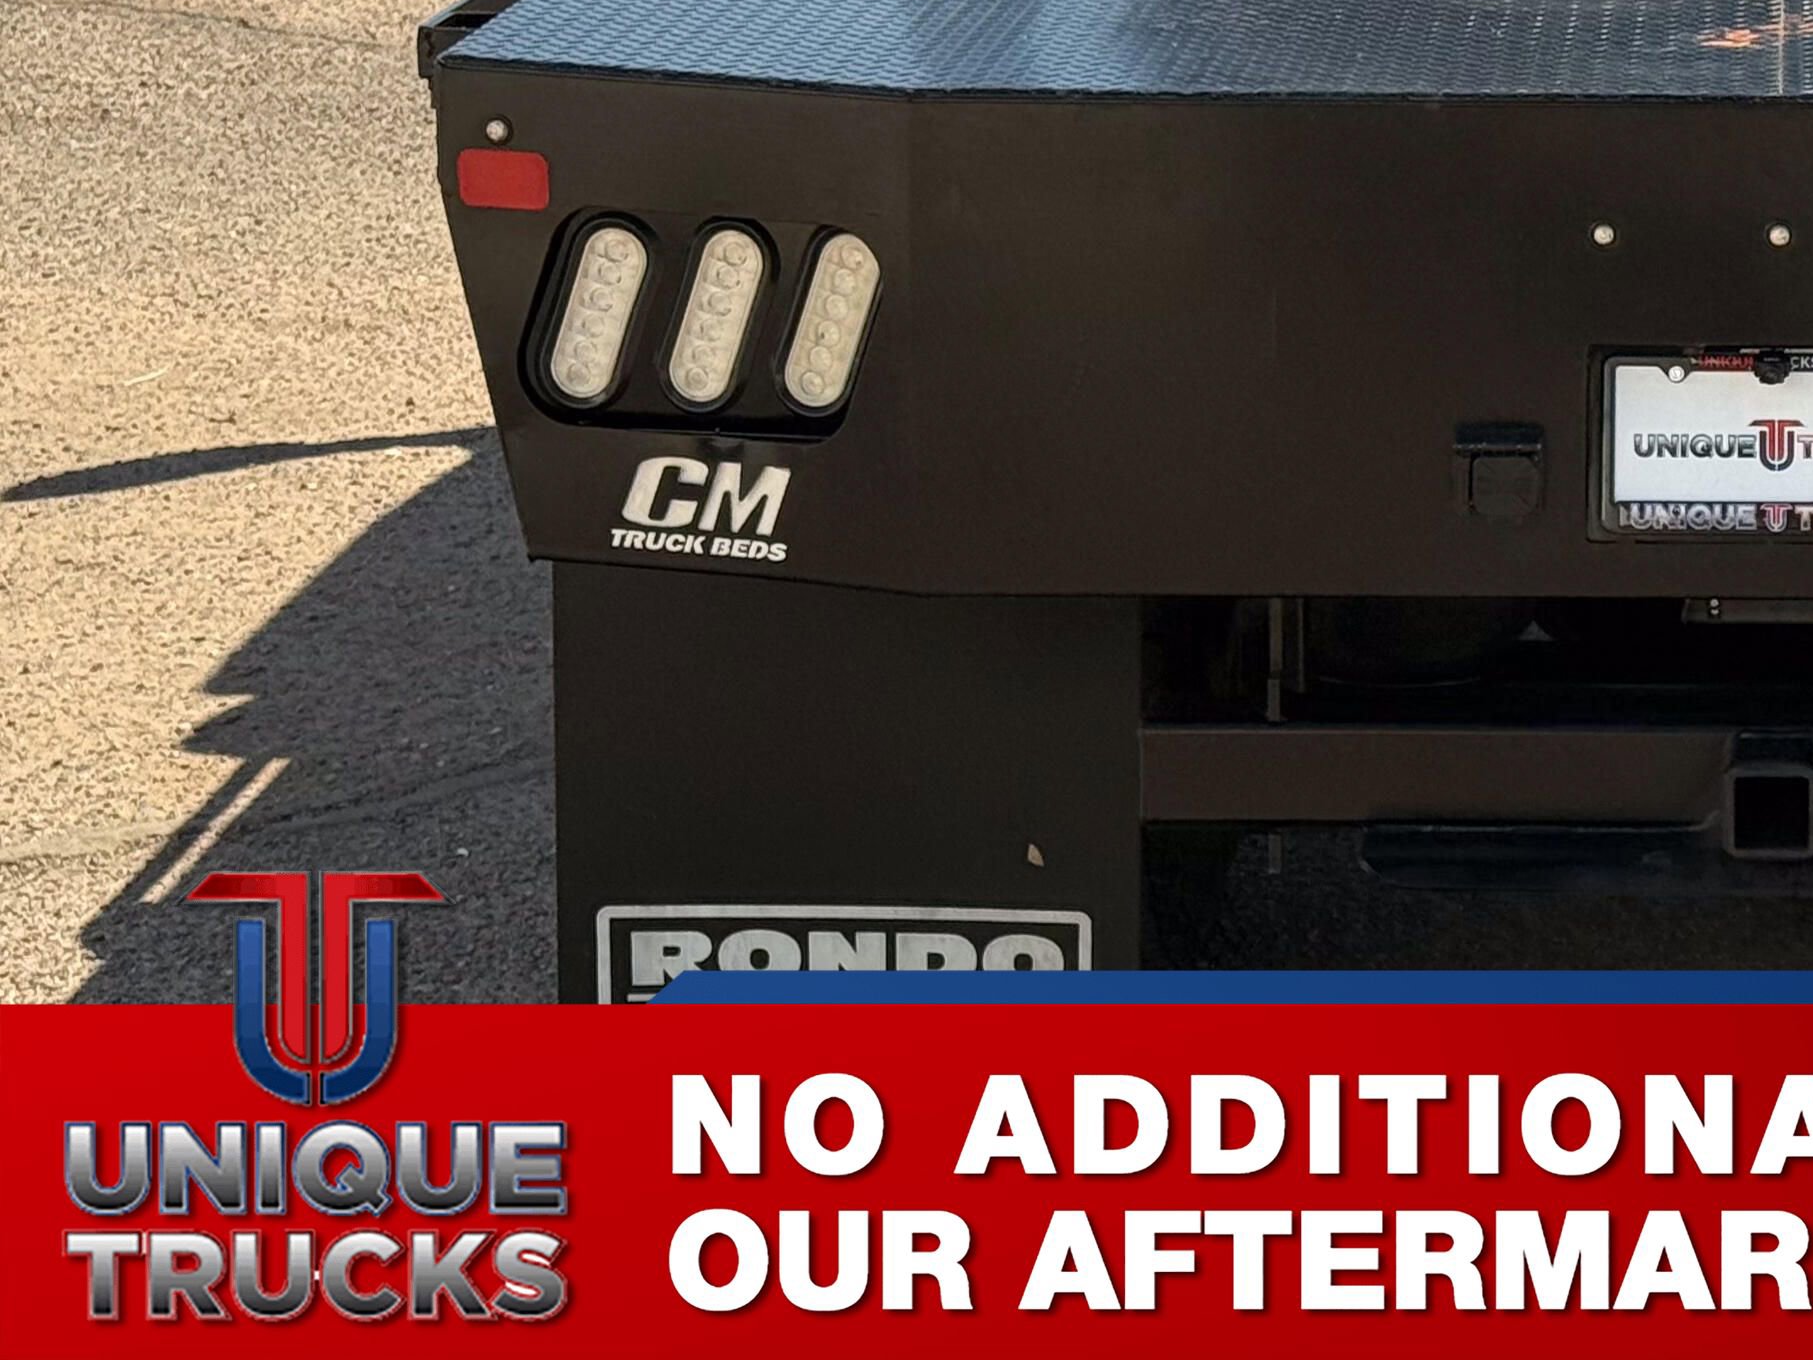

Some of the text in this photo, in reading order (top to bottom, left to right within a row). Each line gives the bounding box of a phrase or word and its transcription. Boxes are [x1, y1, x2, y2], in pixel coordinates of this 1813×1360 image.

[1633, 434, 1757, 460] UNIQUE
[621, 456, 792, 537] CM
[1627, 503, 1757, 532] UNIQUE
[611, 529, 788, 562] TRUCK BEDS
